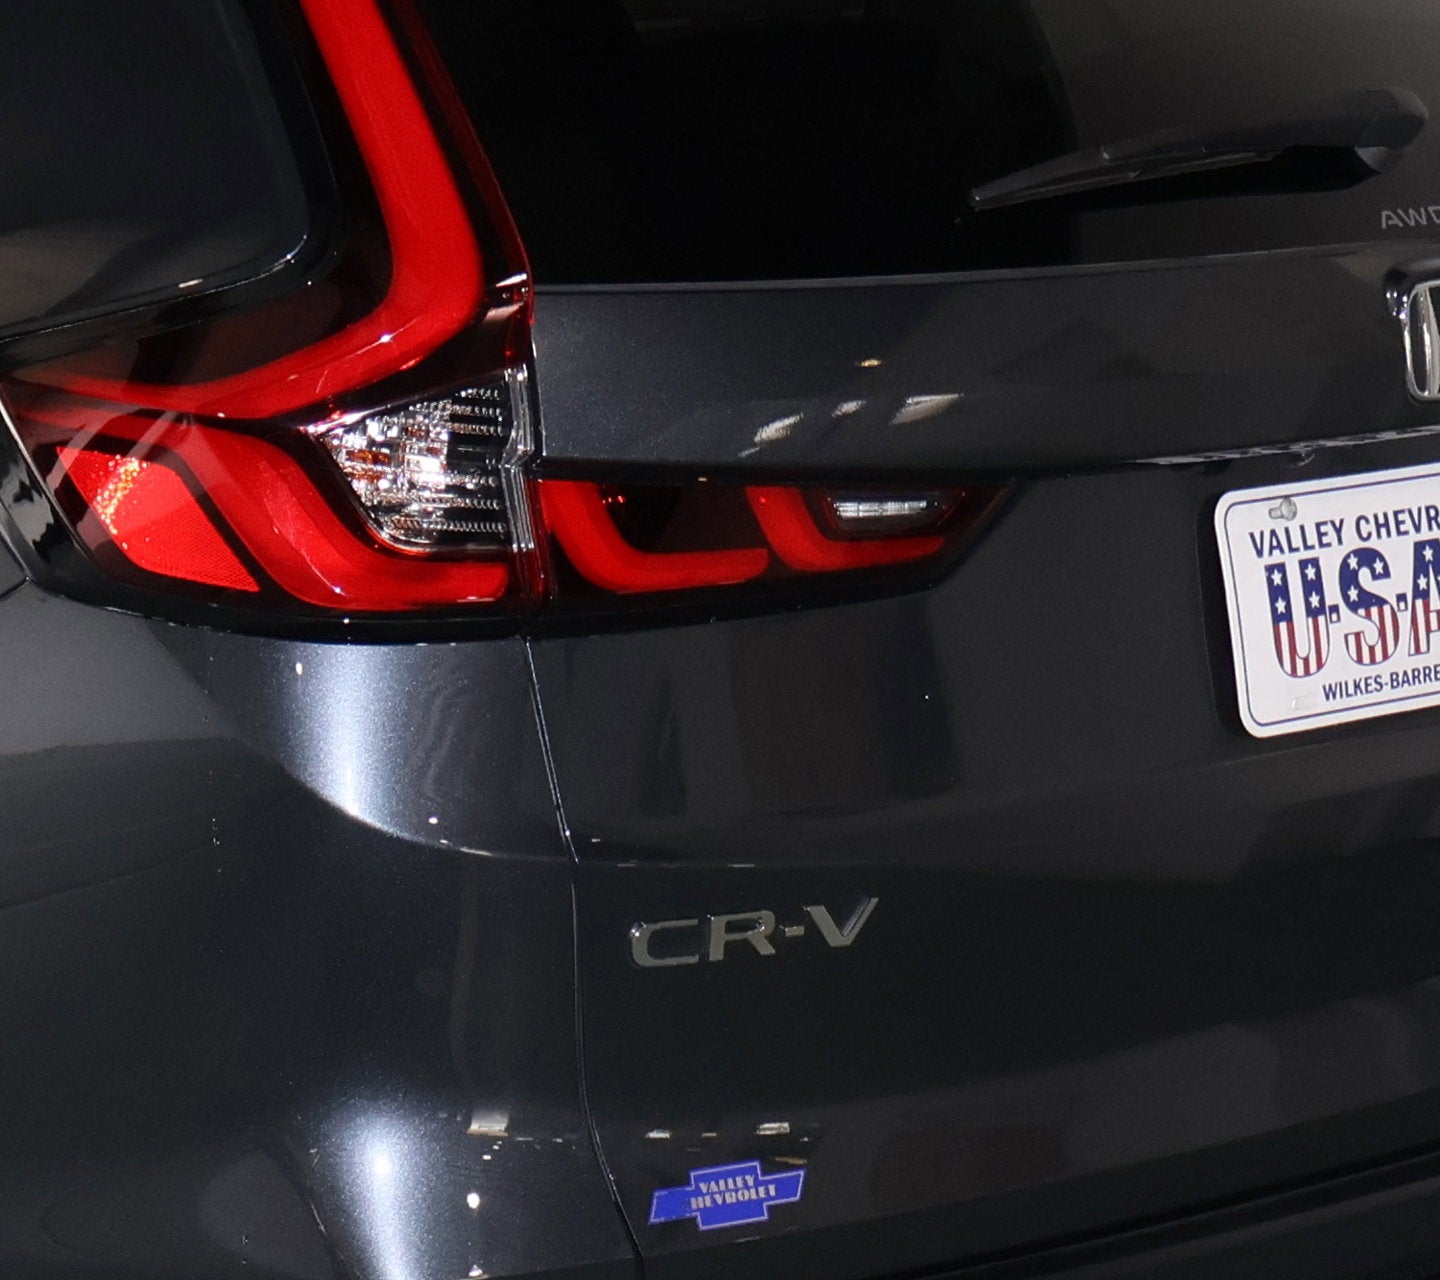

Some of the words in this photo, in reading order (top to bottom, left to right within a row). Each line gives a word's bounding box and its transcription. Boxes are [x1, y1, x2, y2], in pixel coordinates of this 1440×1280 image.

[1248, 519, 1345, 559] VALLEY
[628, 897, 879, 968] CR-V
[684, 1184, 776, 1210] HEVROLET
[698, 1174, 755, 1194] VALLEY
